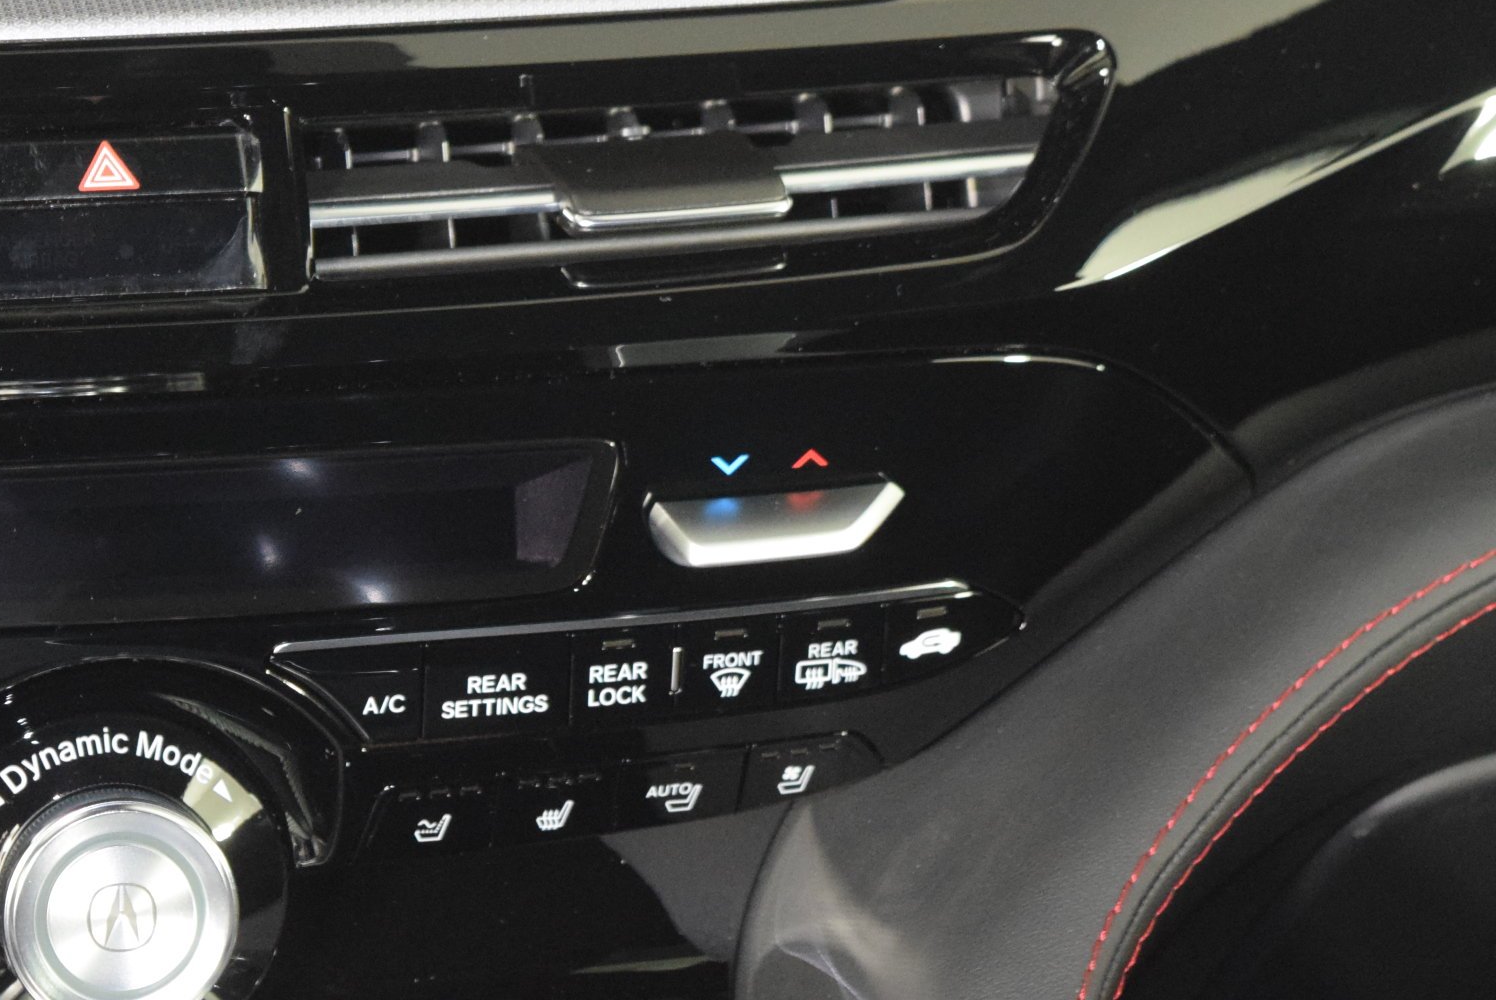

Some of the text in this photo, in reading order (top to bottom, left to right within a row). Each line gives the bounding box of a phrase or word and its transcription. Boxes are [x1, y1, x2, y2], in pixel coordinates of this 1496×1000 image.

[703, 650, 764, 669] FRONT
[808, 640, 858, 658] REAR
[588, 661, 648, 684] REAR
[467, 673, 527, 695] REAR
[363, 694, 407, 716] A/C
[441, 694, 549, 720] SETTINGS
[588, 684, 647, 708] LOCK
[136, 730, 213, 784] Mode
[646, 782, 692, 799] AUTO
